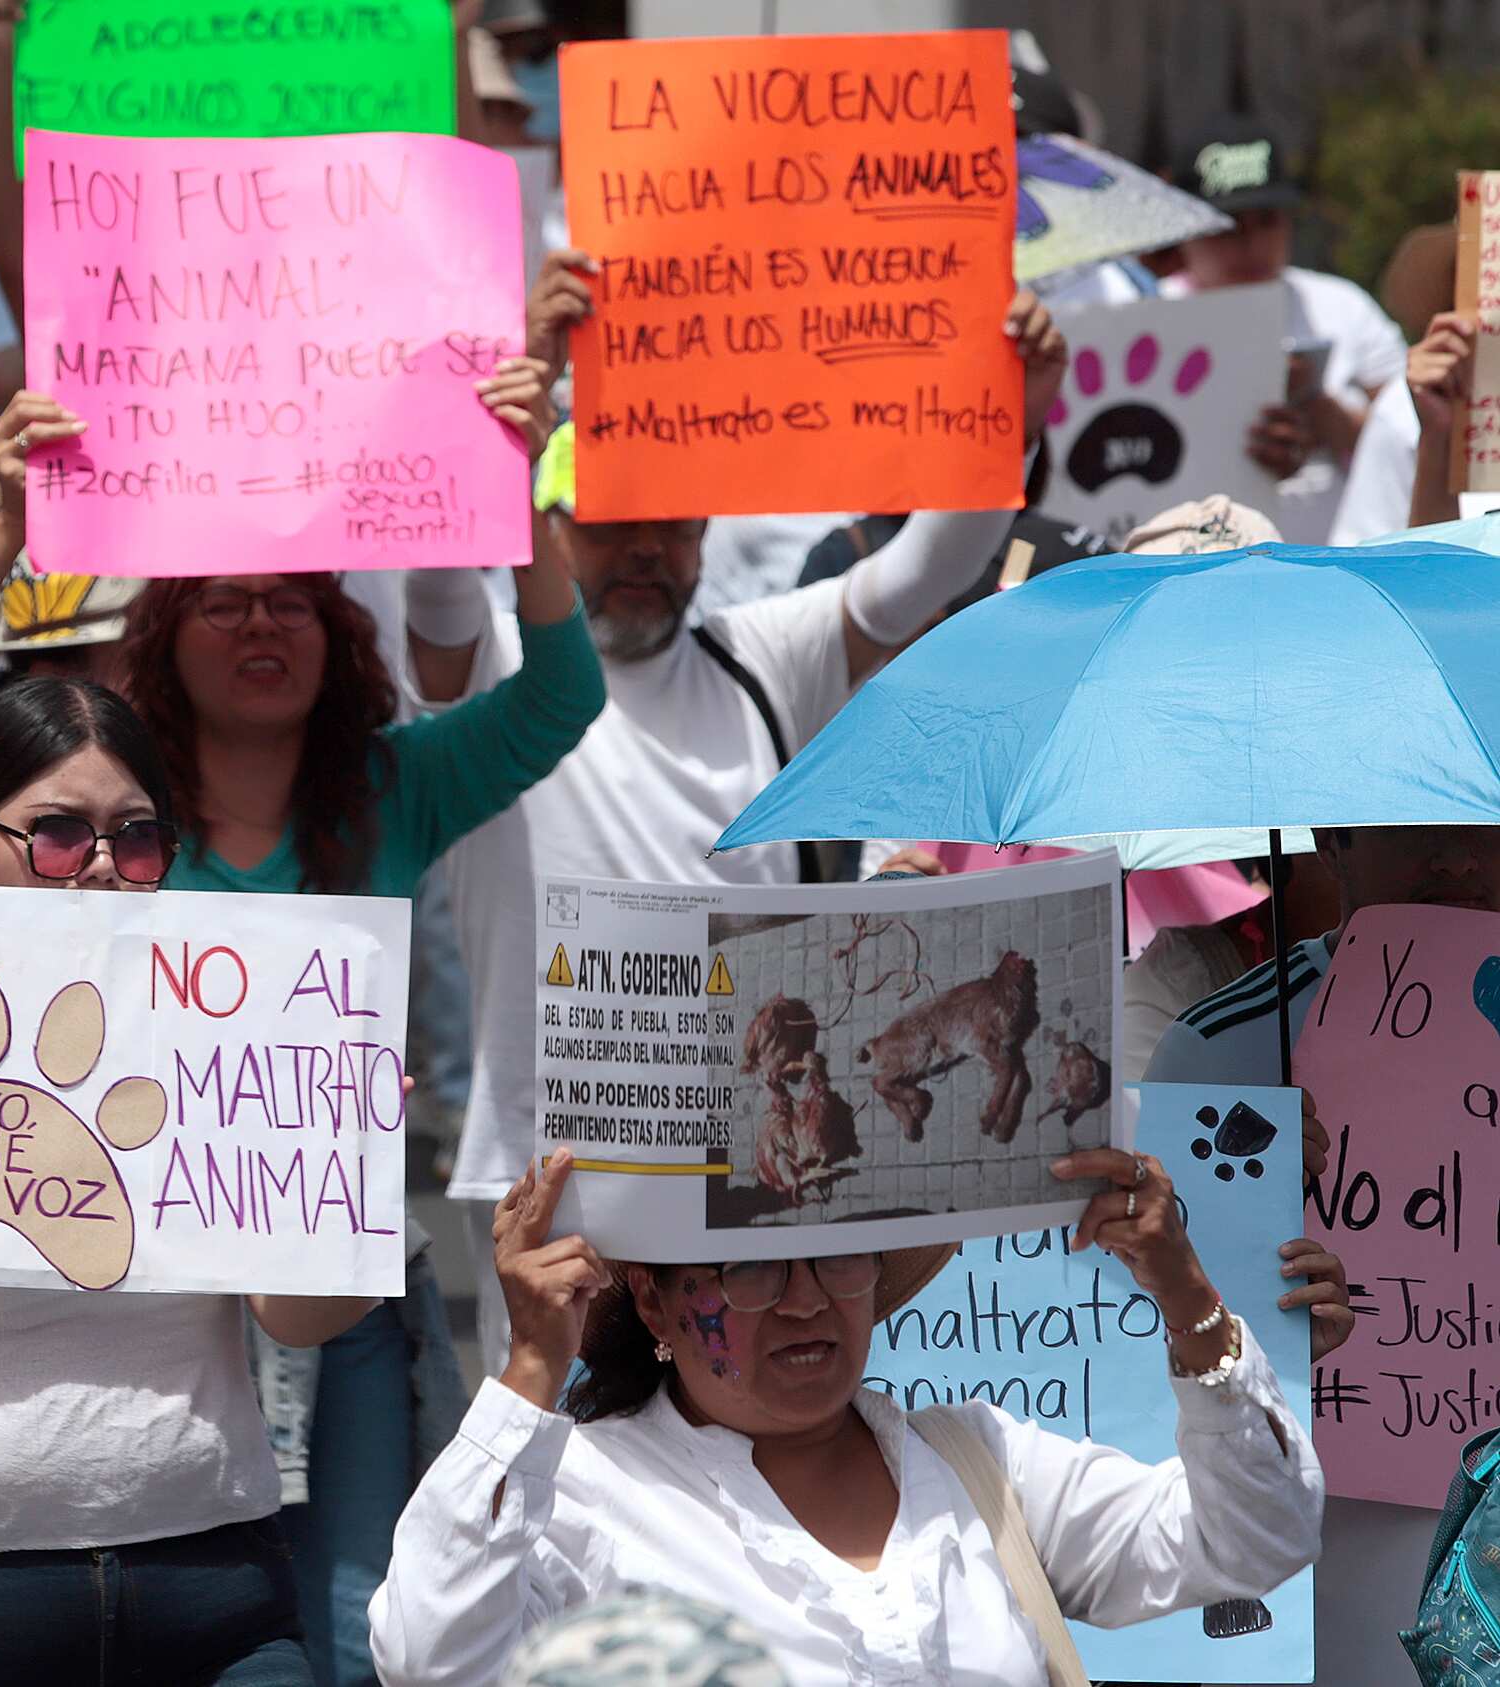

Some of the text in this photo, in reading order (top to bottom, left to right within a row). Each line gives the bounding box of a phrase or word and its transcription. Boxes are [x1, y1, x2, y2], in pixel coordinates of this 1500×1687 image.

[91, 4, 418, 57] ADOLESCENTES
[610, 67, 976, 132] LA VIOLENCIA
[49, 160, 140, 242] HOY
[170, 167, 290, 240] FUE
[325, 154, 409, 228] UN
[601, 146, 1009, 225] HACIA LOS ANIMALES
[601, 242, 970, 304] TAMBIÉN ES VIOLENCIA
[605, 300, 959, 368] HACIA LOS HUMANOS
[54, 342, 263, 388] MAÑANA
[299, 339, 423, 386] PUEDE
[853, 385, 1013, 447] maltrato
[340, 475, 458, 511] sexual
[347, 510, 476, 551] infantil
[152, 942, 381, 1018] NO AL
[621, 951, 702, 998] GOBIERNO
[545, 1004, 735, 1038] DEL ESTADO DE PUEBLA, ESTOS SON
[544, 1036, 735, 1066] ALGUNOS EJEMPLOS DEL MALTRATO ANIMAL
[174, 1040, 406, 1138] MALTRATO
[545, 1078, 733, 1111] YA NO PODEMOS SEGUIR
[544, 1113, 734, 1147] PERMITIENDO ESTAS ATROCIDADES.
[4, 1176, 118, 1222] VOZ
[152, 1137, 398, 1236] ANIMAL
